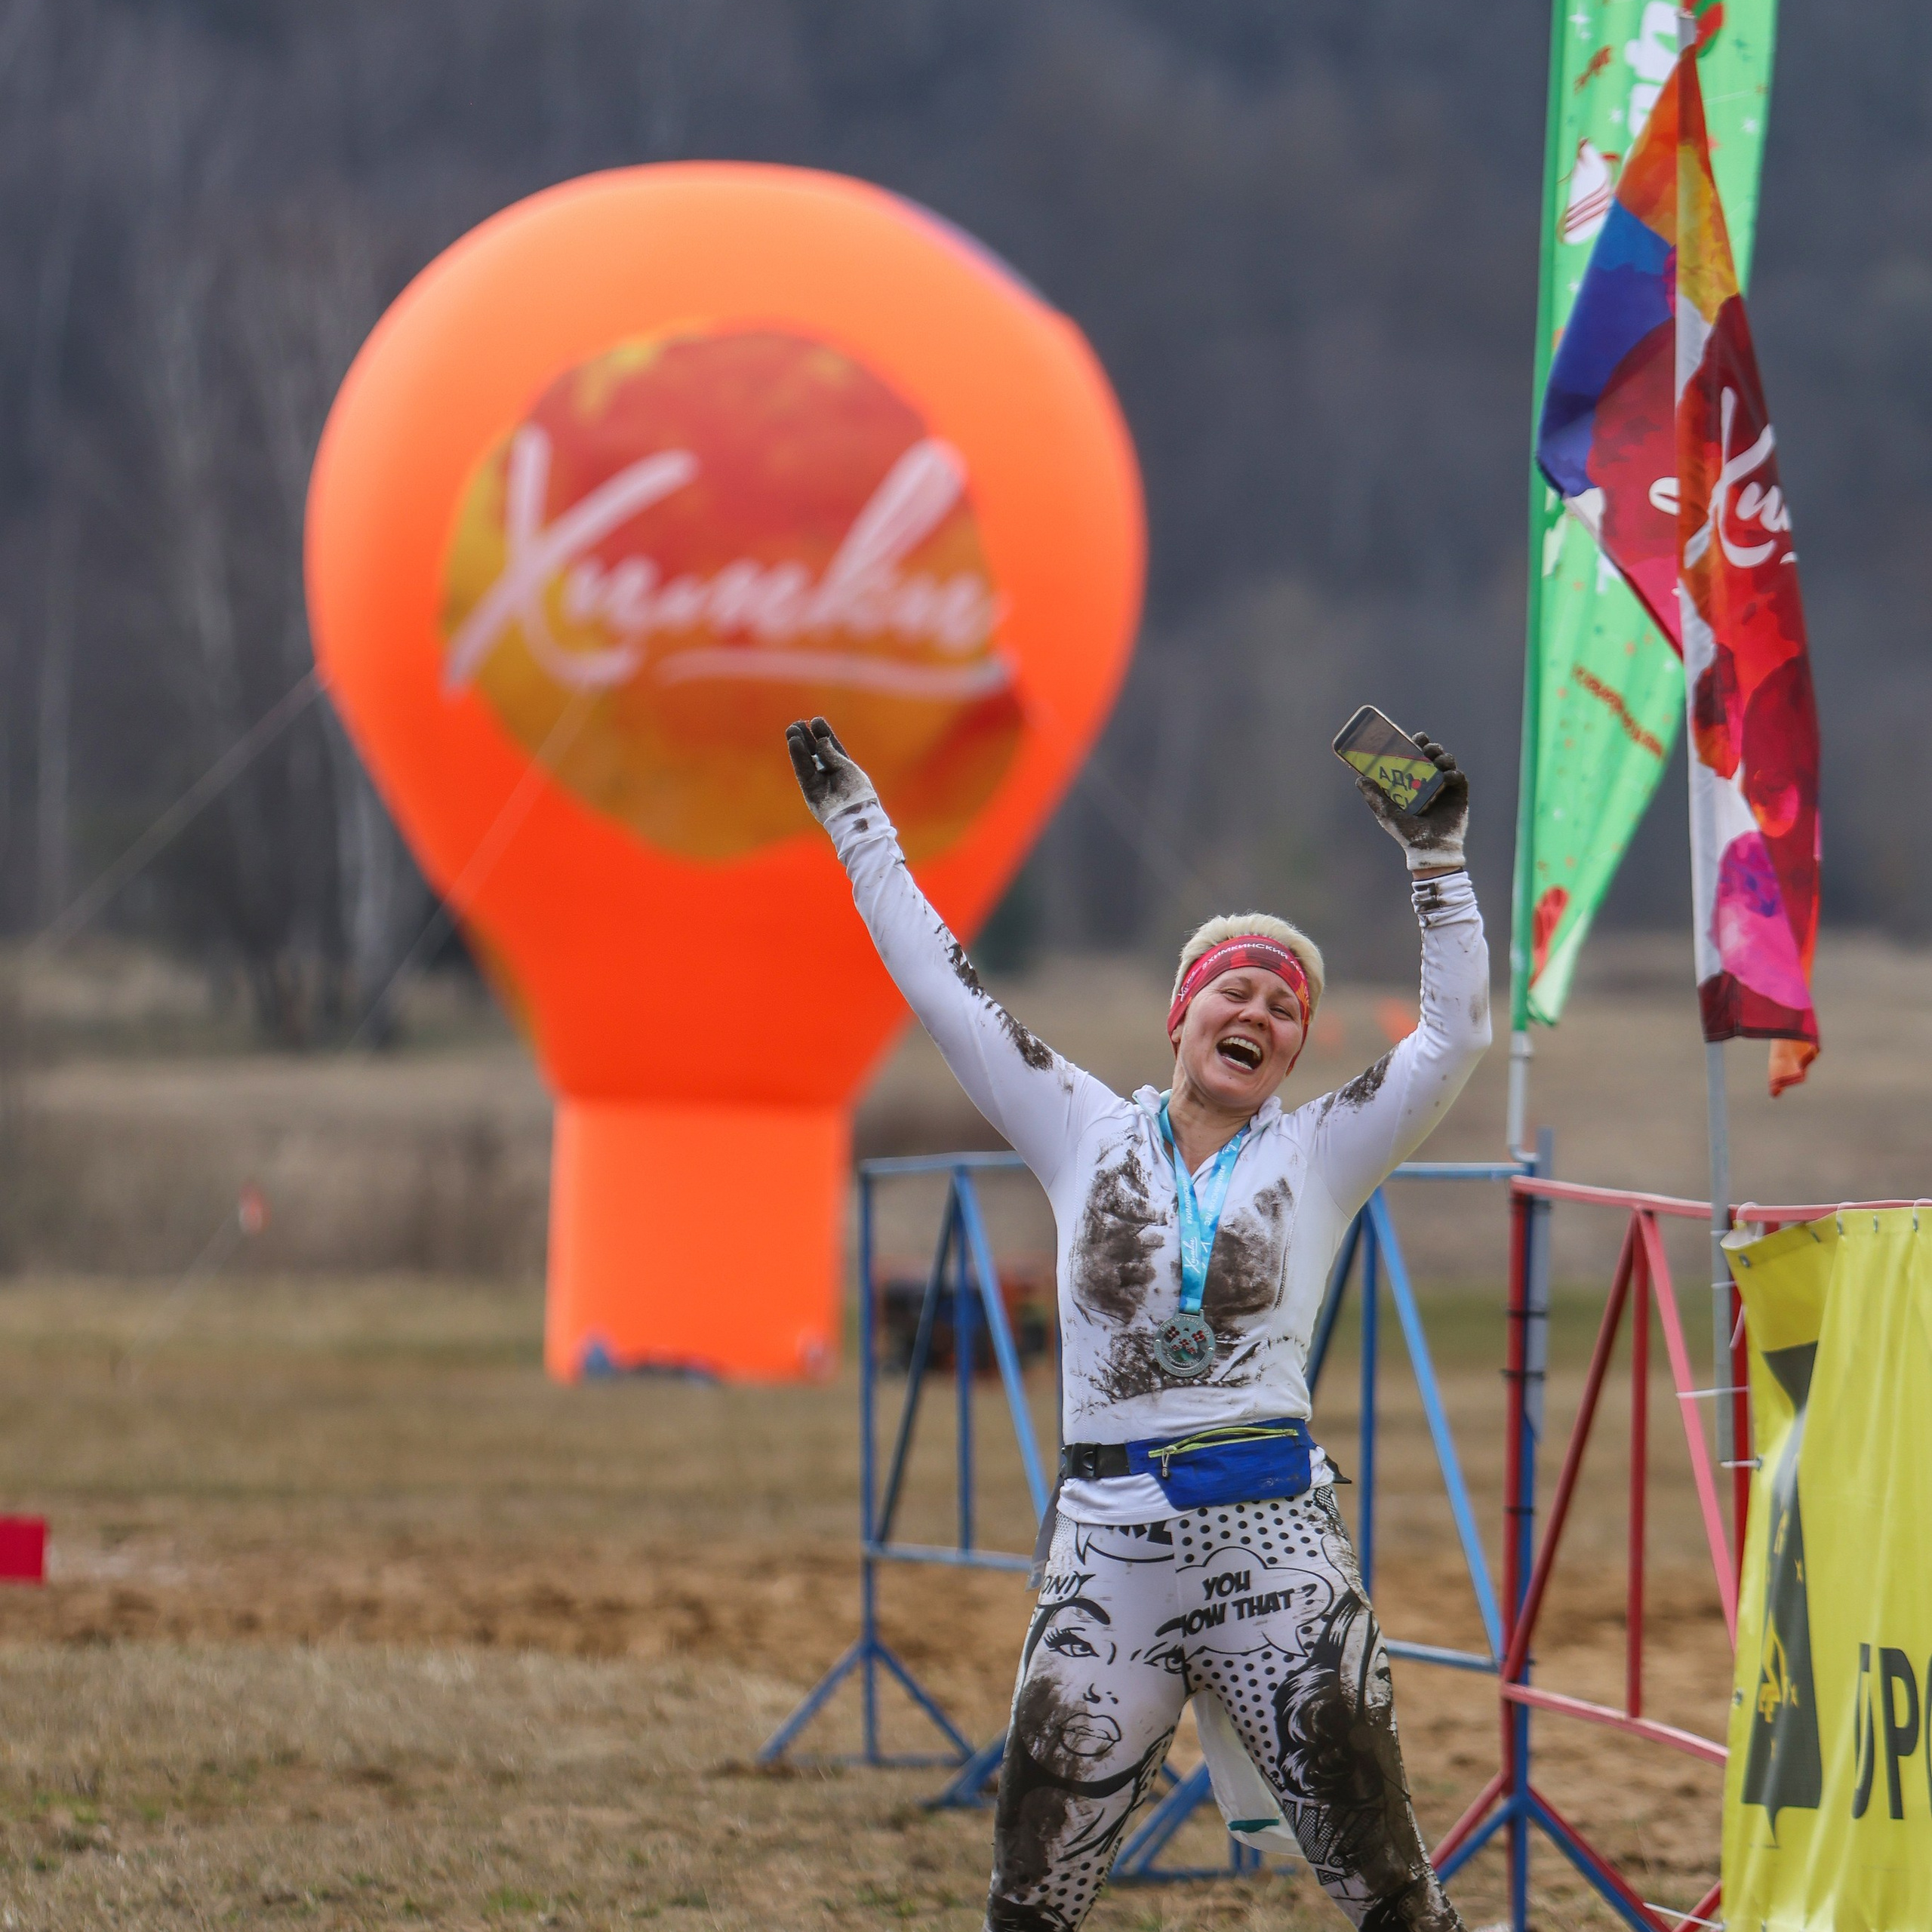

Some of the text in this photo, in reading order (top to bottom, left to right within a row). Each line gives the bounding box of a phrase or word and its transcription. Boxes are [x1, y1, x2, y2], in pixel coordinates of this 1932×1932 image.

[442, 423, 1011, 697] Химки
[1203, 943, 1288, 970] #ХИМКИНСКИЙ
[1201, 1570, 1250, 1601] YOU
